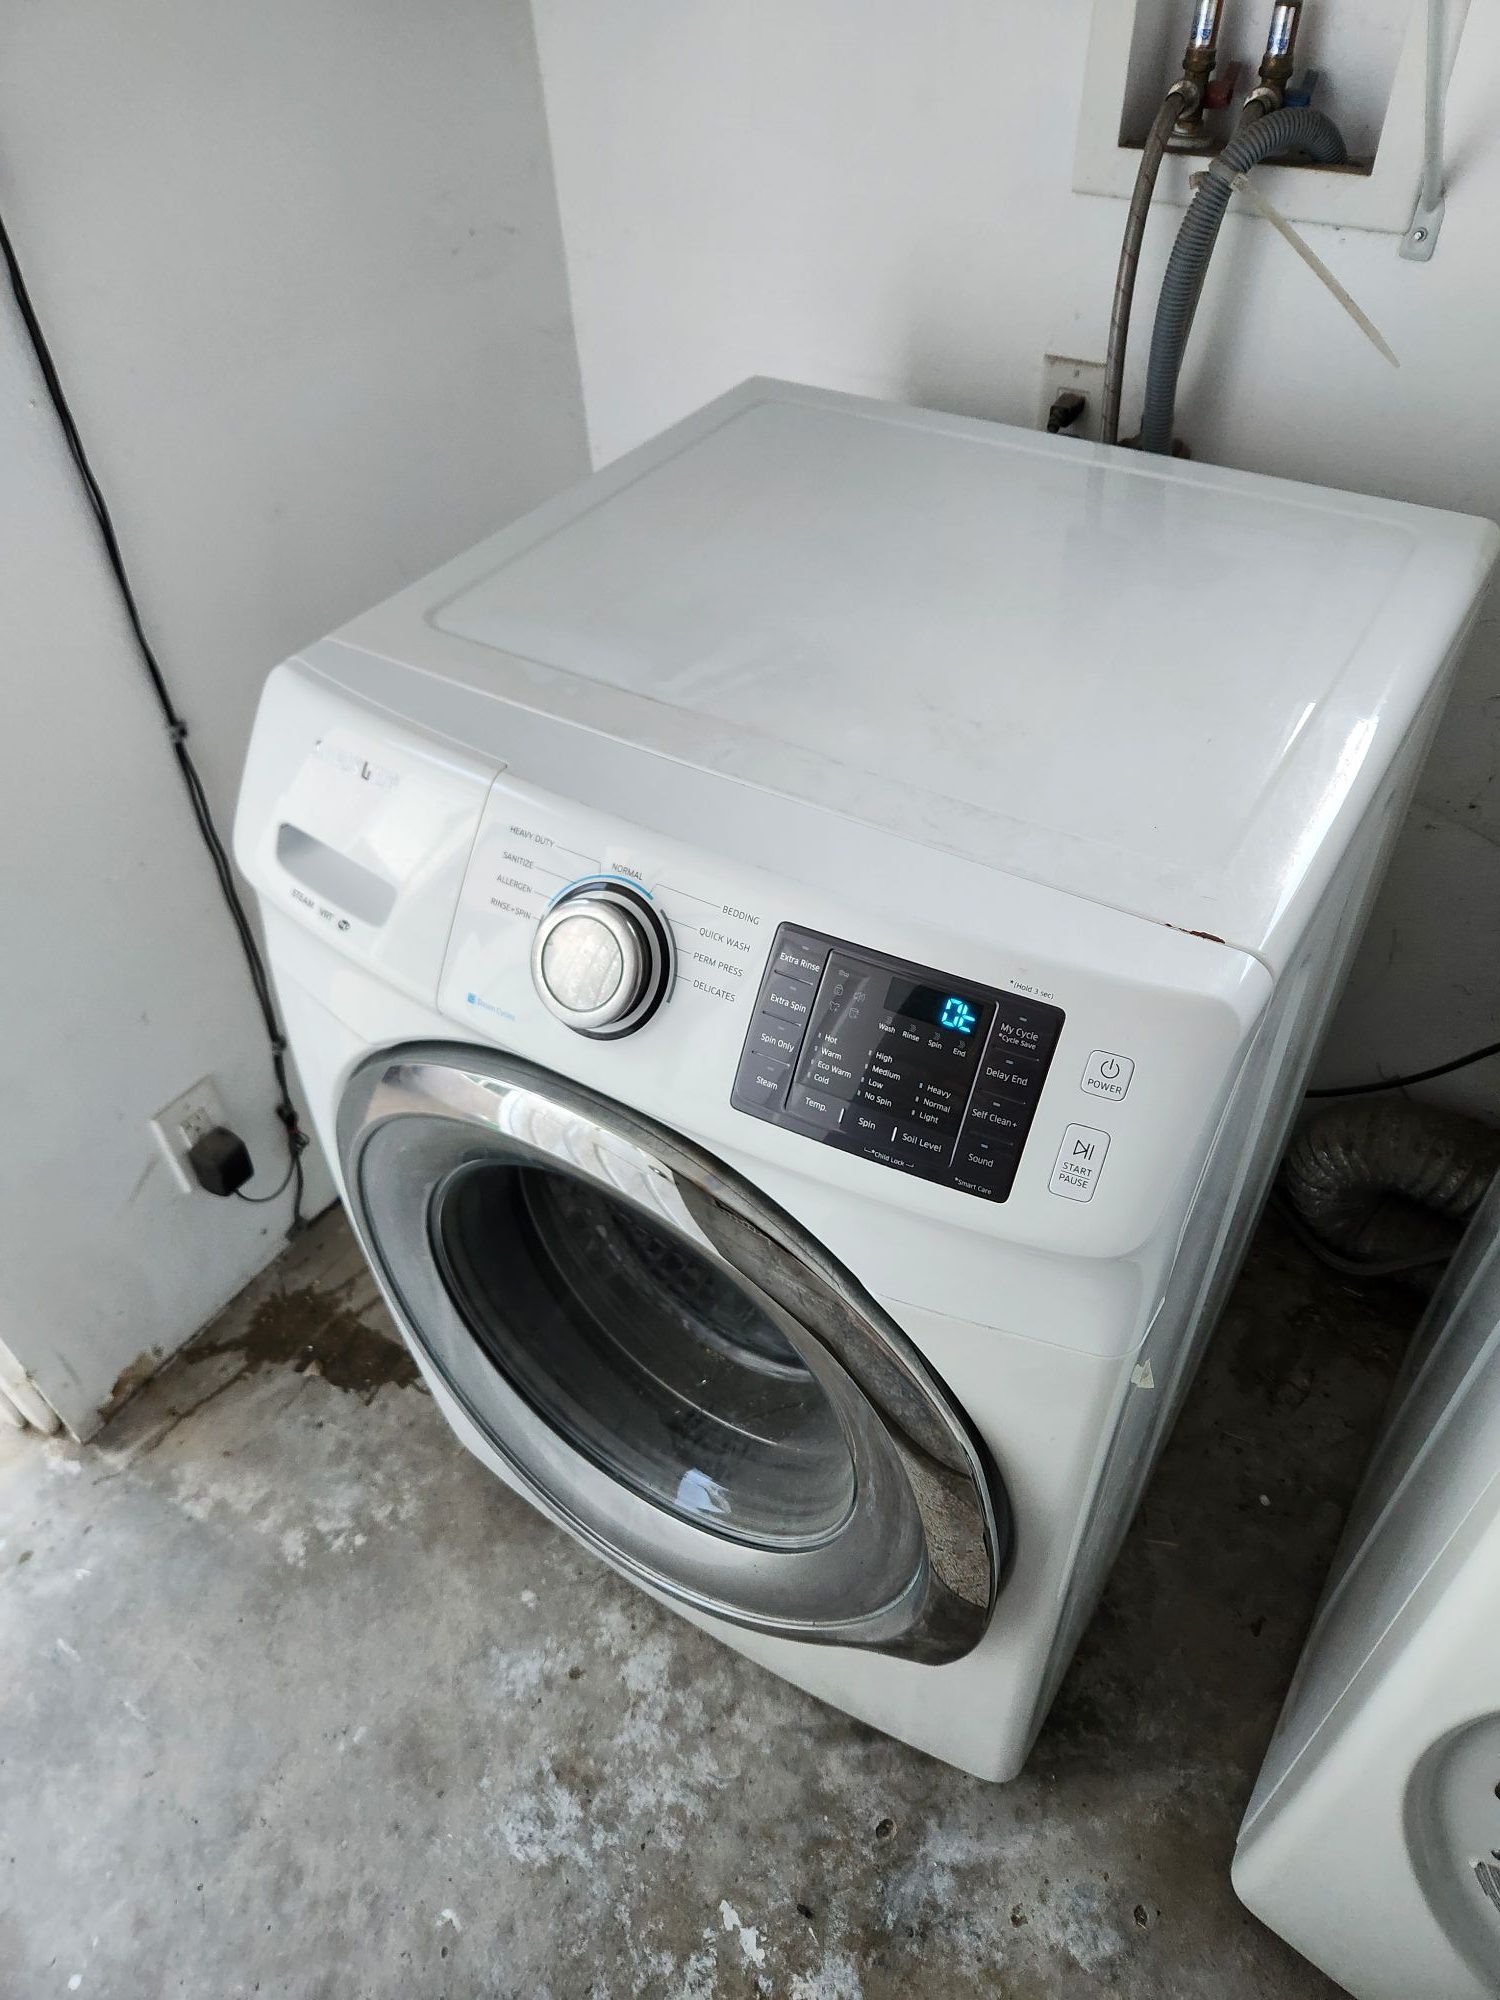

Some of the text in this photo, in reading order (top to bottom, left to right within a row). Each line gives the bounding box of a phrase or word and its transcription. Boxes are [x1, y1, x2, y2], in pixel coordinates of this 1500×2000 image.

[503, 851, 534, 869] SANITIZE
[612, 863, 643, 881] NORMAL
[497, 874, 533, 893] ALLERGEN
[722, 905, 761, 926] BEDDING
[699, 927, 751, 953] QUICK WASH
[693, 952, 744, 977] PERM PRESS
[779, 952, 821, 973] Extra Rinse
[693, 979, 736, 1002] DELICATES
[770, 993, 807, 1014] Extra Spin
[878, 1022, 896, 1034] Wash
[902, 1030, 920, 1042] Rinse
[1000, 1022, 1039, 1042] My Cycle
[760, 1033, 795, 1053] Spin Only
[824, 1033, 838, 1045] Hot
[927, 1039, 943, 1051] Spin
[1020, 1039, 1037, 1050] Save
[821, 1045, 842, 1060] Warm
[875, 1051, 893, 1064] High
[952, 1047, 967, 1058] End
[817, 1060, 852, 1079] Eco Warm
[871, 1064, 901, 1081] Medium
[985, 1066, 1029, 1087] Delay End
[755, 1075, 778, 1091] Steam
[813, 1073, 830, 1085] Cold
[868, 1078, 884, 1089] Low
[1086, 1077, 1123, 1095] POWER
[864, 1091, 892, 1108] No Spin
[926, 1084, 952, 1099] Heavy
[804, 1096, 828, 1113] Temp.
[922, 1097, 951, 1113] Normal
[919, 1111, 940, 1124] Light
[971, 1108, 988, 1120] Self
[857, 1117, 876, 1131] Spin
[901, 1132, 943, 1153] Soil Level
[890, 1156, 905, 1167] Lock
[967, 1152, 994, 1168] Sound
[1063, 1161, 1093, 1177] START
[1058, 1172, 1089, 1190] PAUSE
[977, 1184, 993, 1195] Care
